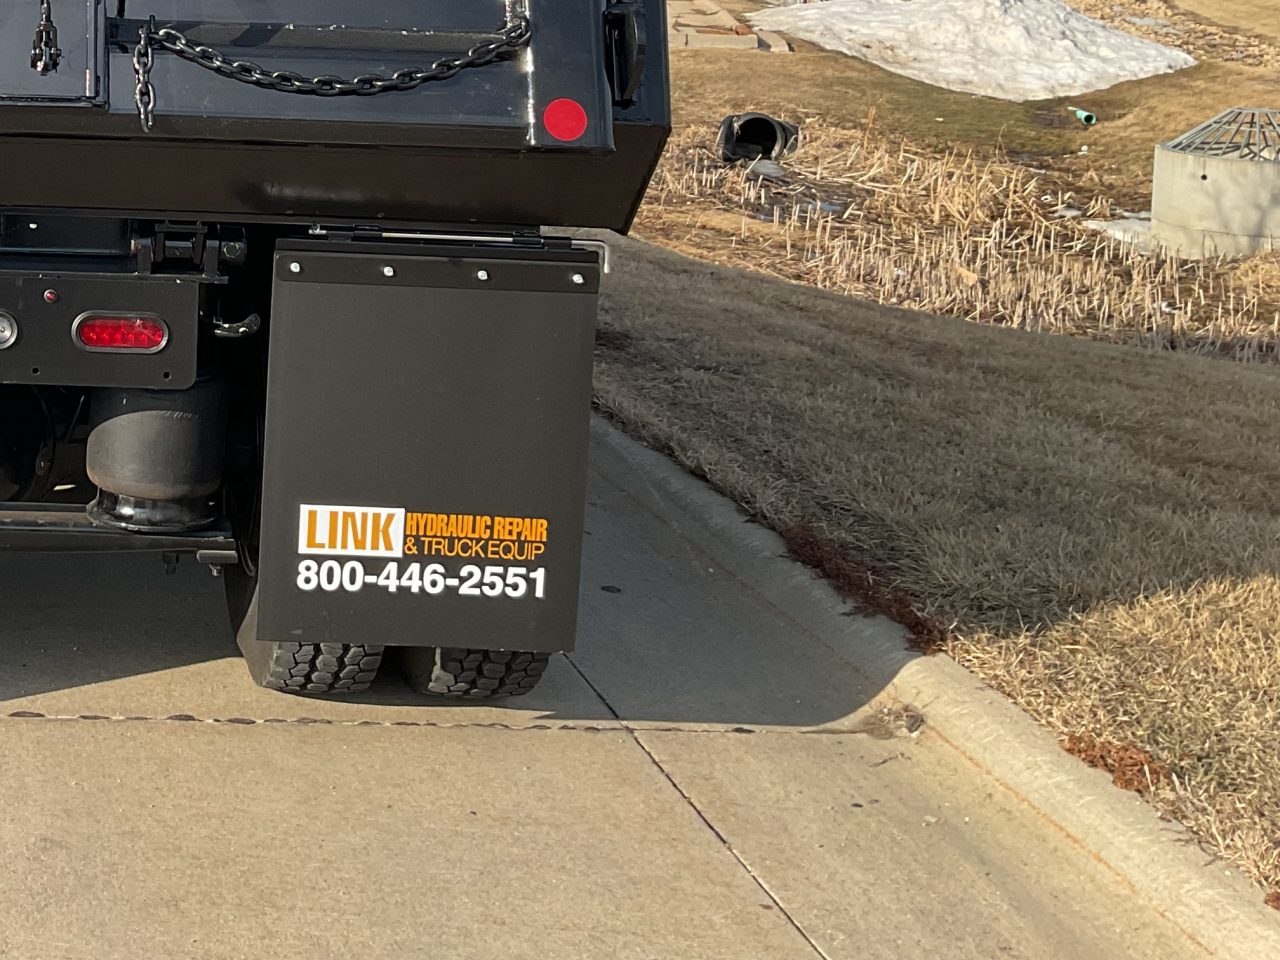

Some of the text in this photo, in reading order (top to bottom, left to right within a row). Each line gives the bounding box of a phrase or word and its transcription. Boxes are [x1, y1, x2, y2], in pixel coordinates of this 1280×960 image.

[306, 509, 396, 552] LINK
[405, 512, 548, 542] HYDRAULIC REPAIR
[404, 537, 545, 561] & TRUCK EQUIP
[296, 559, 546, 598] 800-446-2551
